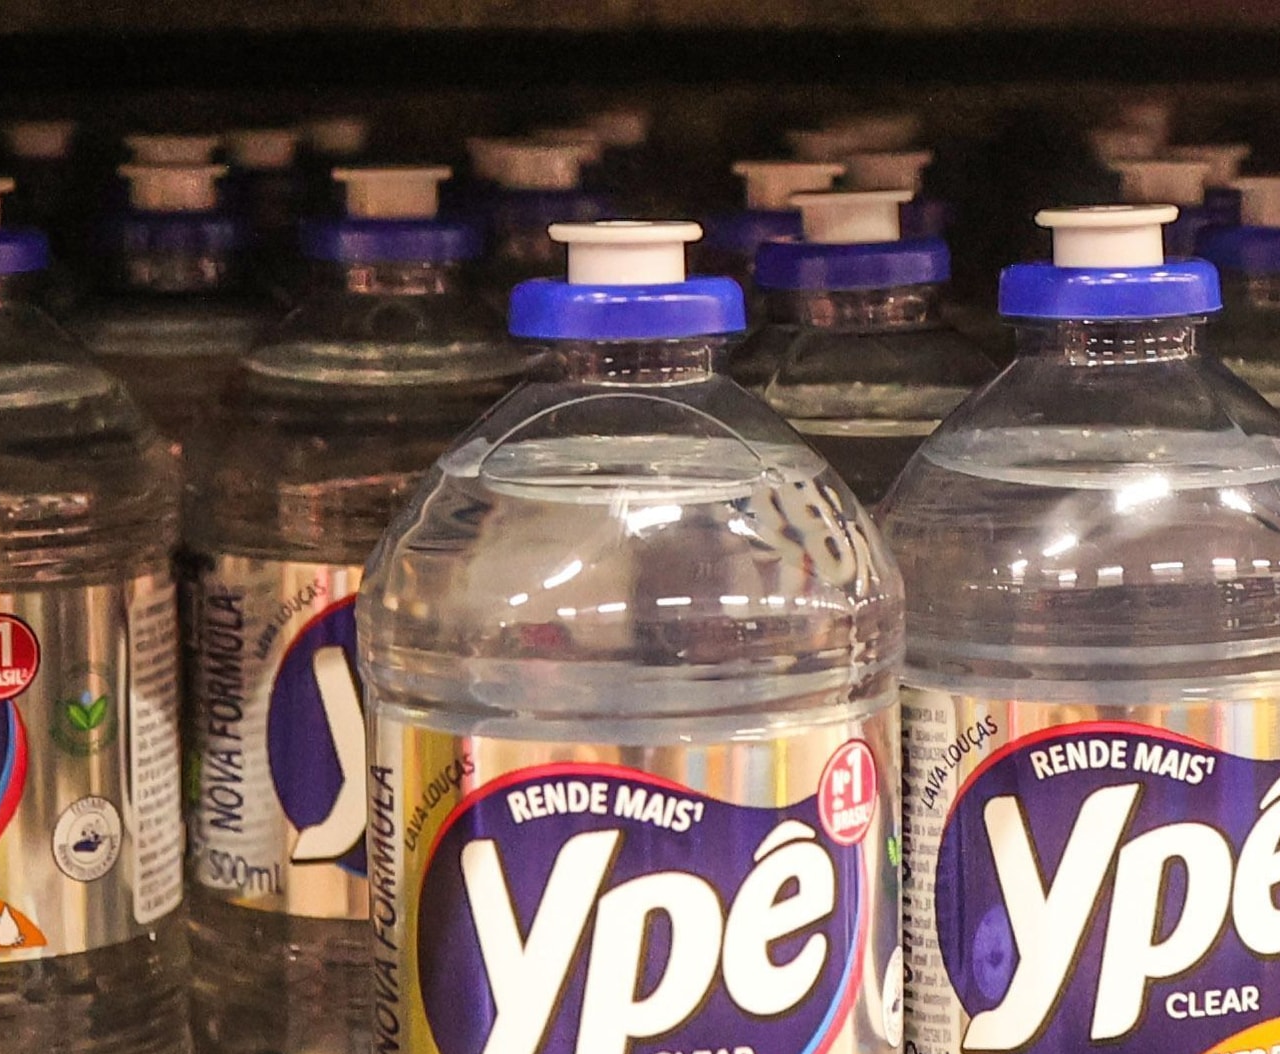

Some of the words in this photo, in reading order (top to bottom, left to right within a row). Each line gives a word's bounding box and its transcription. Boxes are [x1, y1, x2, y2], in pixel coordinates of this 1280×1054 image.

[206, 588, 244, 745] FORMULA
[208, 747, 244, 833] NOVA
[507, 780, 608, 824] RENDE
[921, 714, 998, 809] LAVA-LOUÇAS
[1030, 740, 1127, 780] RENDE
[370, 764, 398, 952] FORMULA
[1166, 986, 1260, 1020] CLEAR
